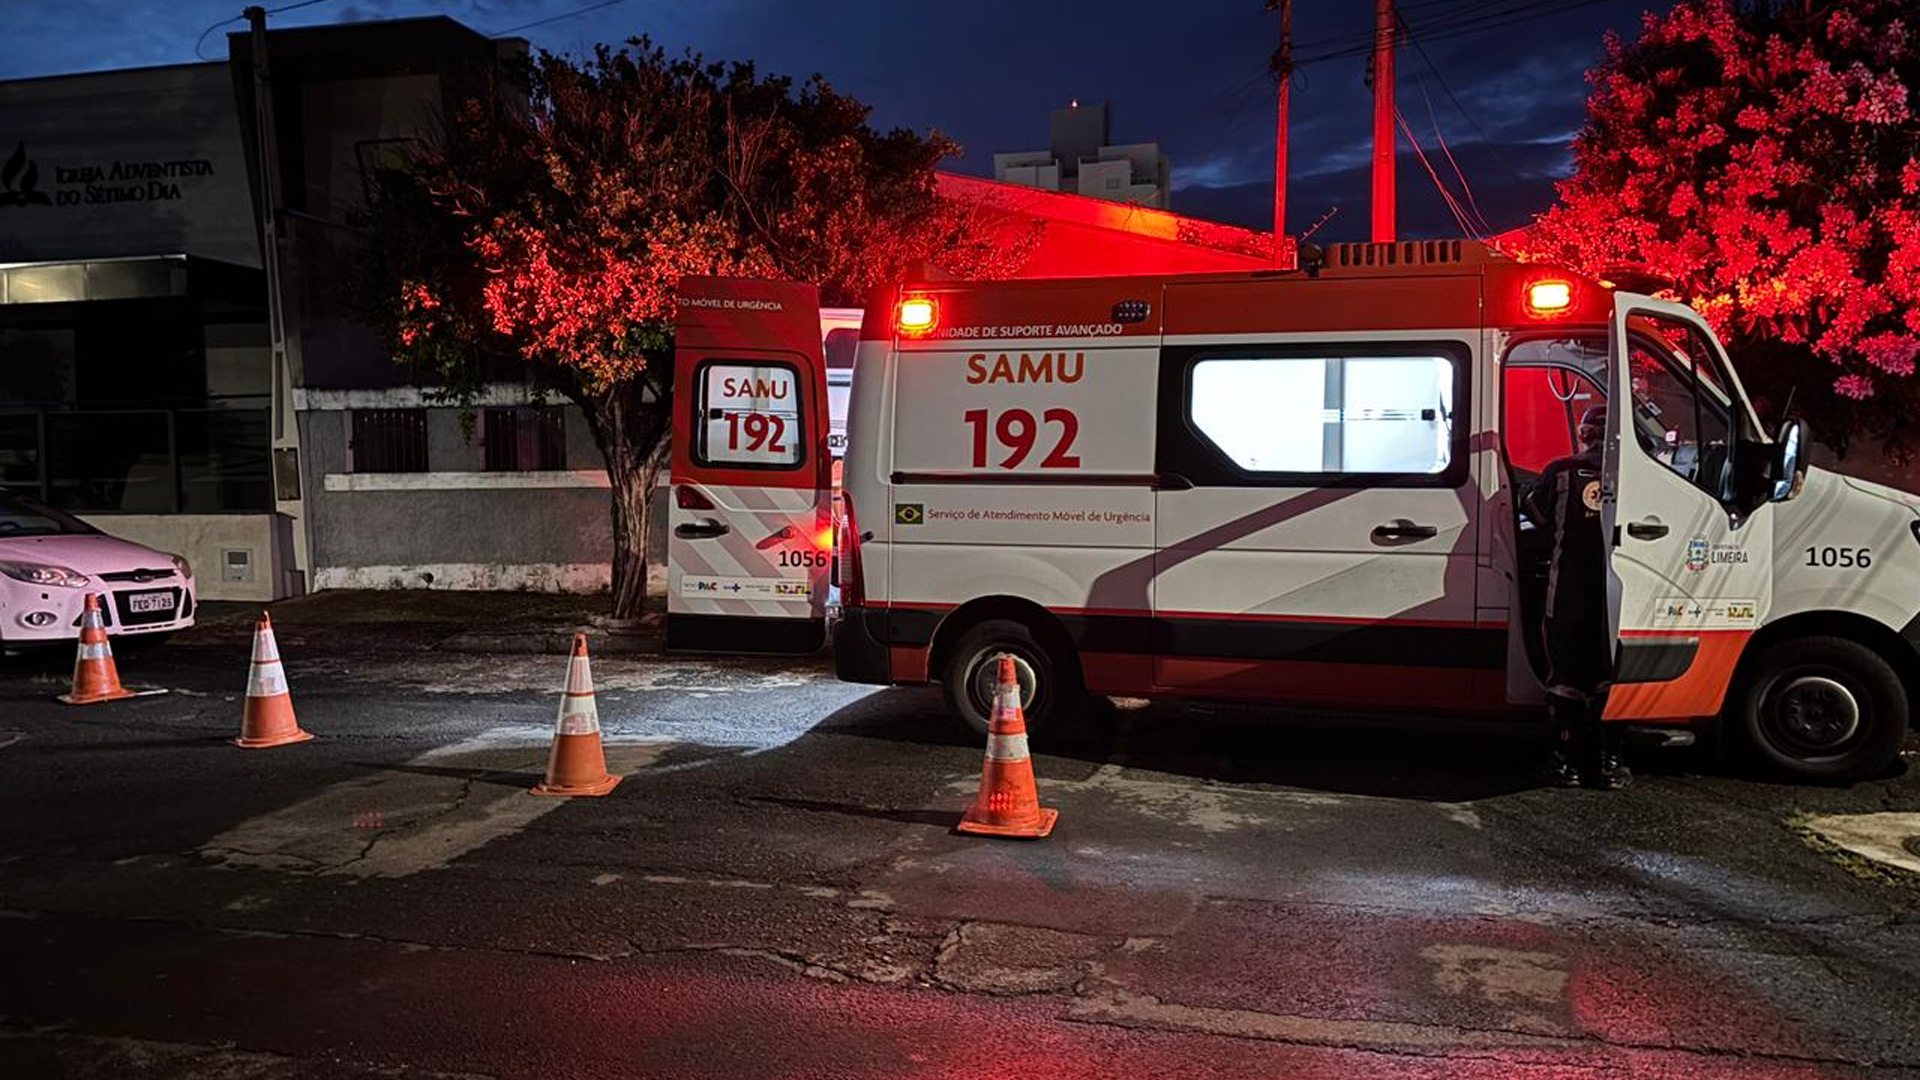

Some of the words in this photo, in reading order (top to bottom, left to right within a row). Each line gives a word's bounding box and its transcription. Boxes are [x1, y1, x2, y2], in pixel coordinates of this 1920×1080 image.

[109, 160, 214, 180] ADVENTISTA
[57, 190, 80, 206] DO
[148, 181, 181, 200] DIA
[724, 300, 735, 309] DE
[982, 326, 998, 338] DE
[1000, 325, 1052, 337] SUPORTE
[1055, 323, 1123, 338] AVANÇADO
[966, 352, 1085, 384] SAMU
[723, 378, 788, 400] SAMU
[724, 413, 787, 453] 192
[964, 408, 1081, 470] 192
[927, 509, 965, 521] Serviço
[967, 509, 980, 519] de
[982, 509, 1050, 521] Atendimento
[1052, 509, 1085, 522] Móvel
[1088, 511, 1101, 522] de
[1104, 511, 1151, 525] Urgência
[778, 550, 827, 567] 1056
[1711, 551, 1748, 563] LIMEIRA
[1804, 547, 1871, 568] 1056
